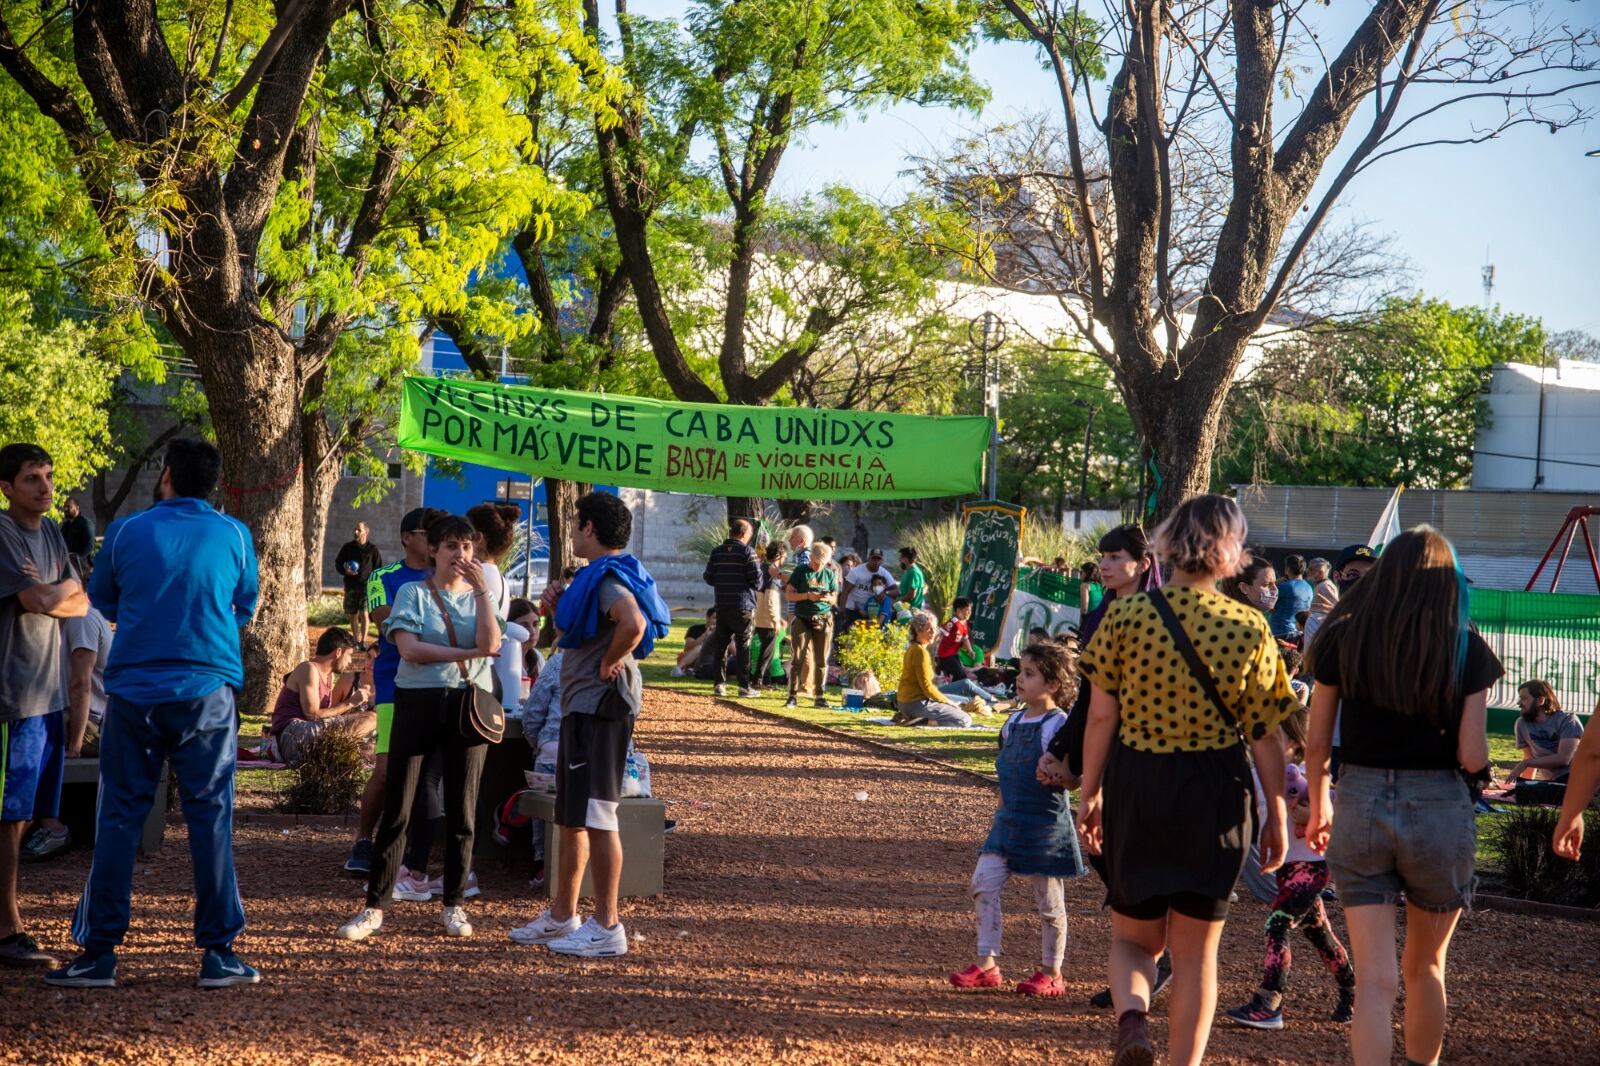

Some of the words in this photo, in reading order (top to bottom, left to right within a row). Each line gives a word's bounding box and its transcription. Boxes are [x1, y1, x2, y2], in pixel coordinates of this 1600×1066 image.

[422, 408, 483, 448] POR
[492, 422, 551, 461] MÁS
[556, 431, 654, 475] VERDE
[591, 402, 637, 432] DE
[665, 409, 760, 444] CABA
[666, 444, 728, 482] BASTA
[734, 453, 750, 469] DE
